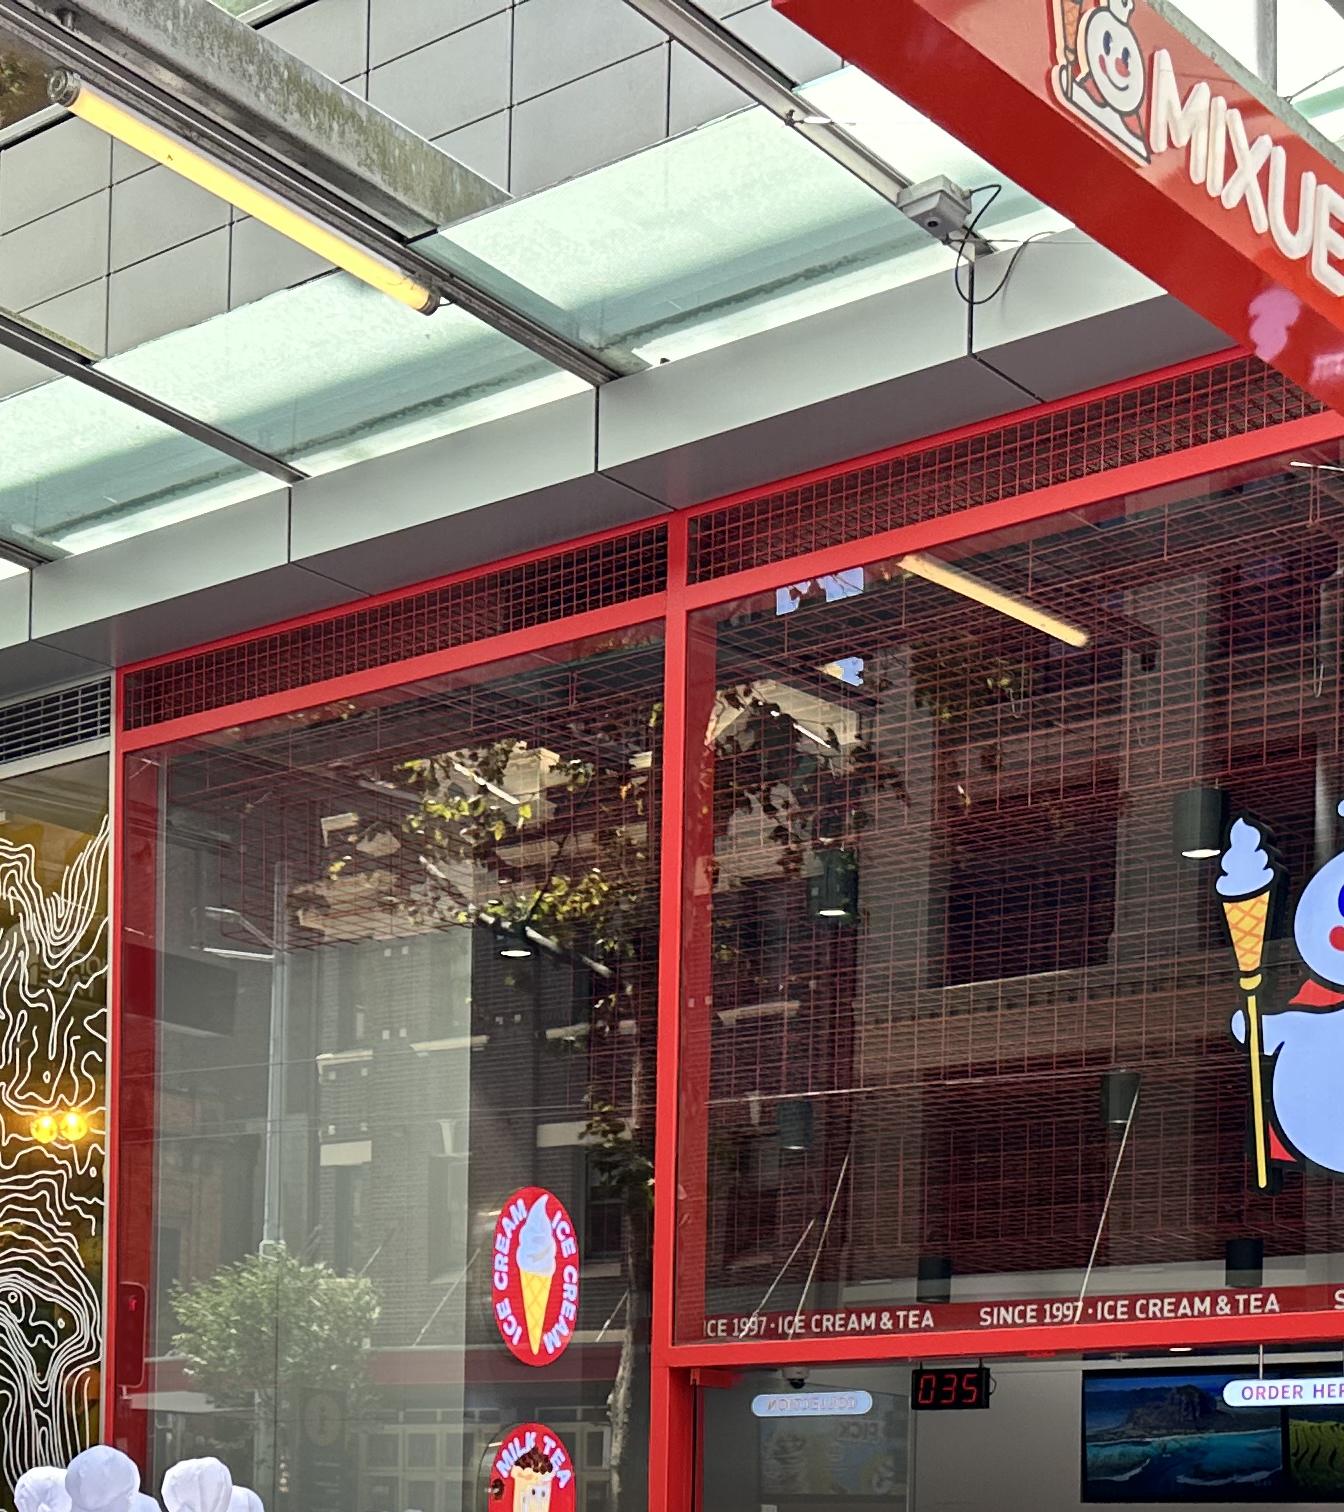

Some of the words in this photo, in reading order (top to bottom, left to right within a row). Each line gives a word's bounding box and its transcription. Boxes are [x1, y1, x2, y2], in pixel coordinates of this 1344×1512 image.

[493, 1198, 528, 1291] CREAM
[551, 1210, 577, 1258] ICE
[495, 1297, 523, 1346] ICE
[542, 1264, 579, 1355] CREAM
[811, 1311, 876, 1332] CREAM
[880, 1311, 893, 1330] &
[898, 1309, 935, 1329] TEA
[979, 1304, 1037, 1326] SINCE
[1135, 1295, 1211, 1319] CREAM
[1215, 1295, 1232, 1315] &
[1234, 1293, 1281, 1314] TEA
[919, 1373, 978, 1405] 035
[1241, 1384, 1304, 1401] ORDER
[495, 1431, 536, 1479] MILK
[542, 1435, 571, 1489] TEA
